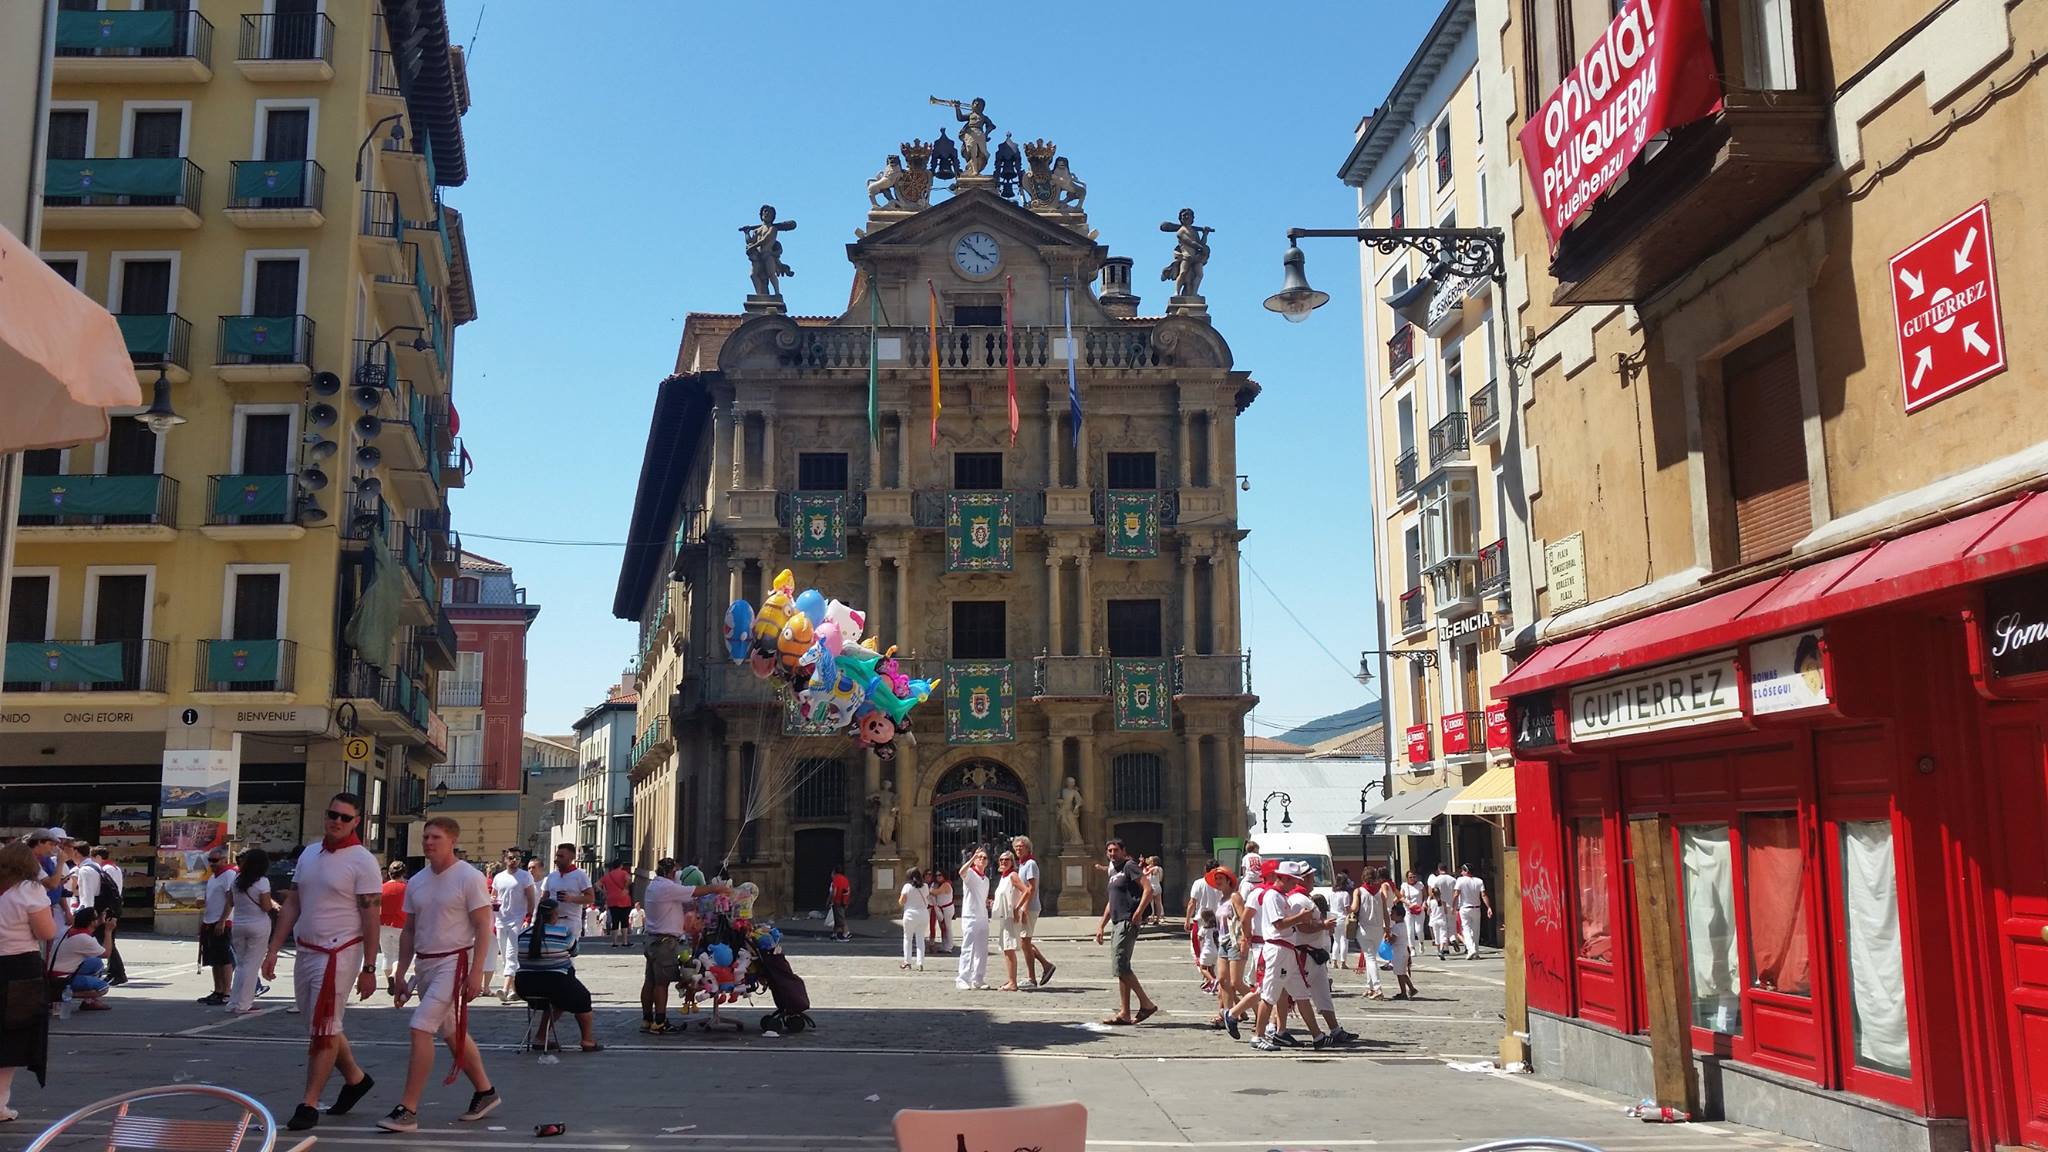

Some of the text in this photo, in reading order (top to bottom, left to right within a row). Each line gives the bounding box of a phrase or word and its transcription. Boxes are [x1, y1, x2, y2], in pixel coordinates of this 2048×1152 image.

[1543, 57, 1656, 208] PELUQUERIA
[1557, 116, 1647, 227] Guelbenzu 30
[1903, 280, 1986, 337] GUTIERREZ
[1440, 612, 1491, 640] AGENCIA
[0, 712, 134, 723] NIDO ONGI ETORRI
[237, 711, 296, 722] BIENVENUE
[1583, 668, 1725, 728] GUTIERREZ
